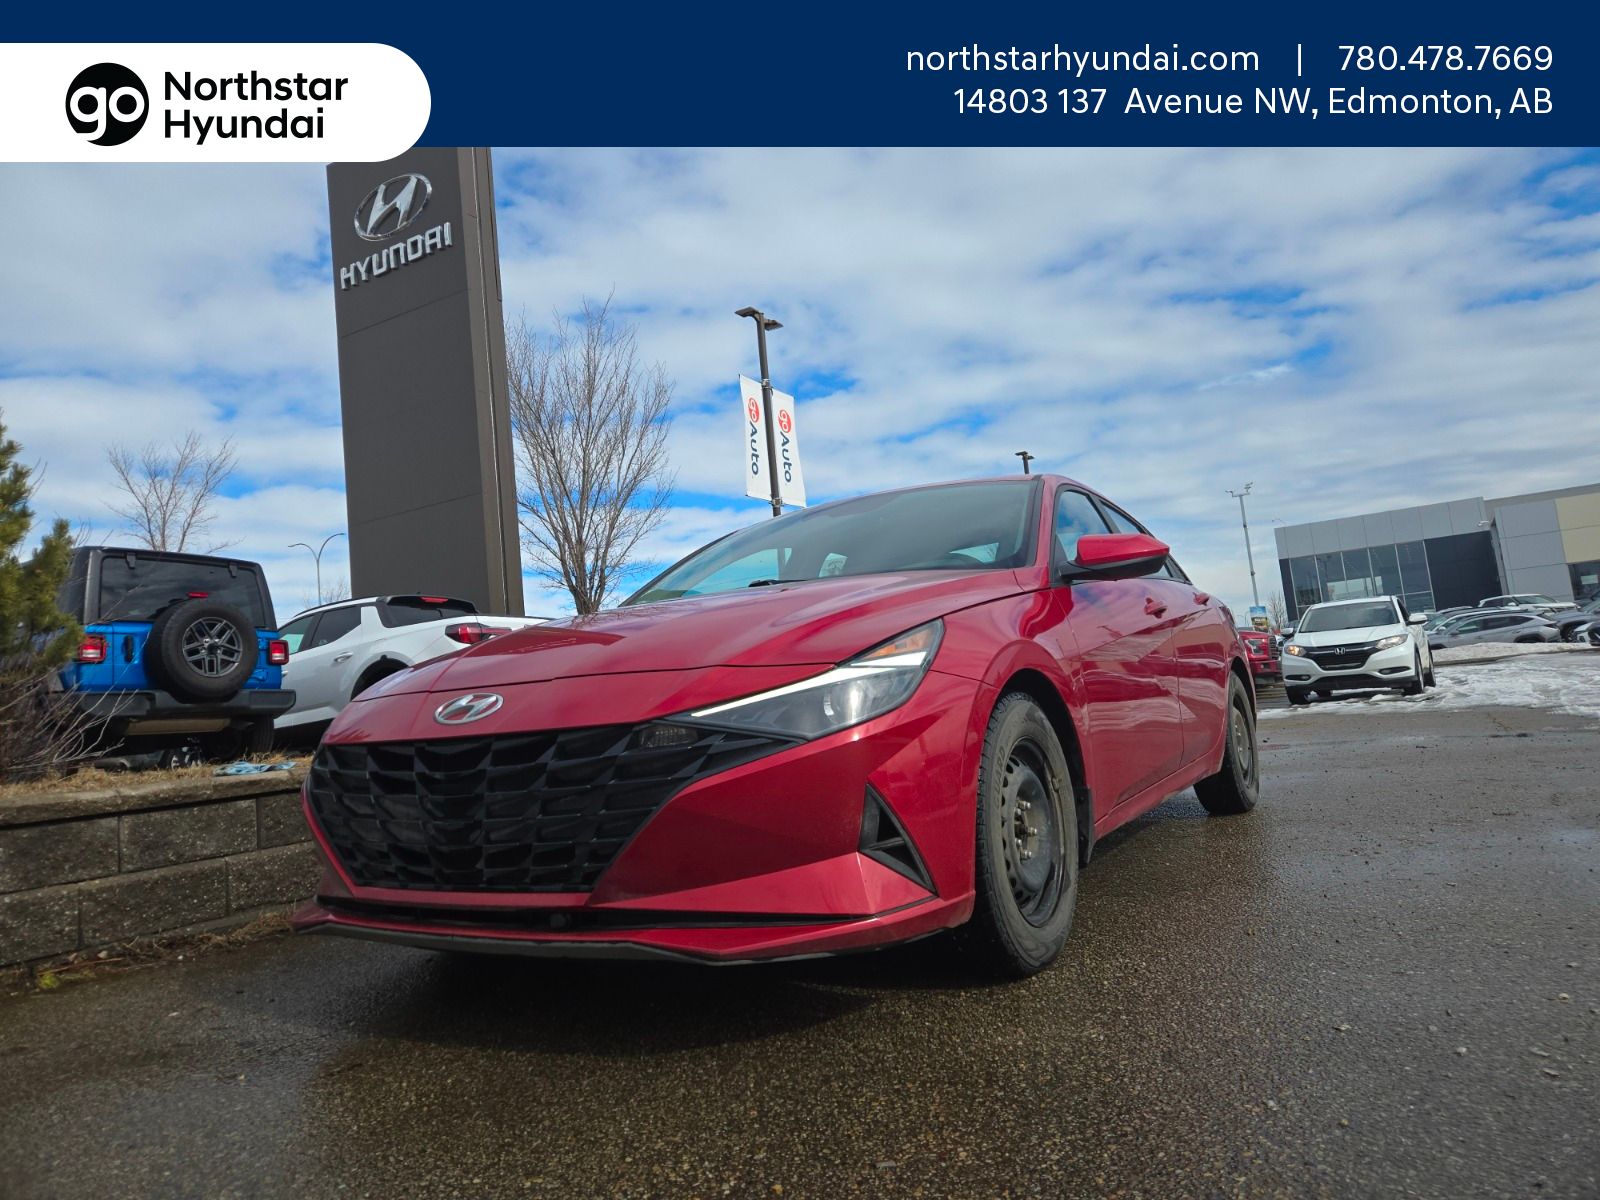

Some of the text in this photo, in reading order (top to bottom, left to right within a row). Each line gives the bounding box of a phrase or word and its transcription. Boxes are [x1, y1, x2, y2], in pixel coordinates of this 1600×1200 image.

[340, 222, 452, 290] HYUNDAI
[750, 421, 760, 475] Auto
[780, 431, 792, 483] Auto
